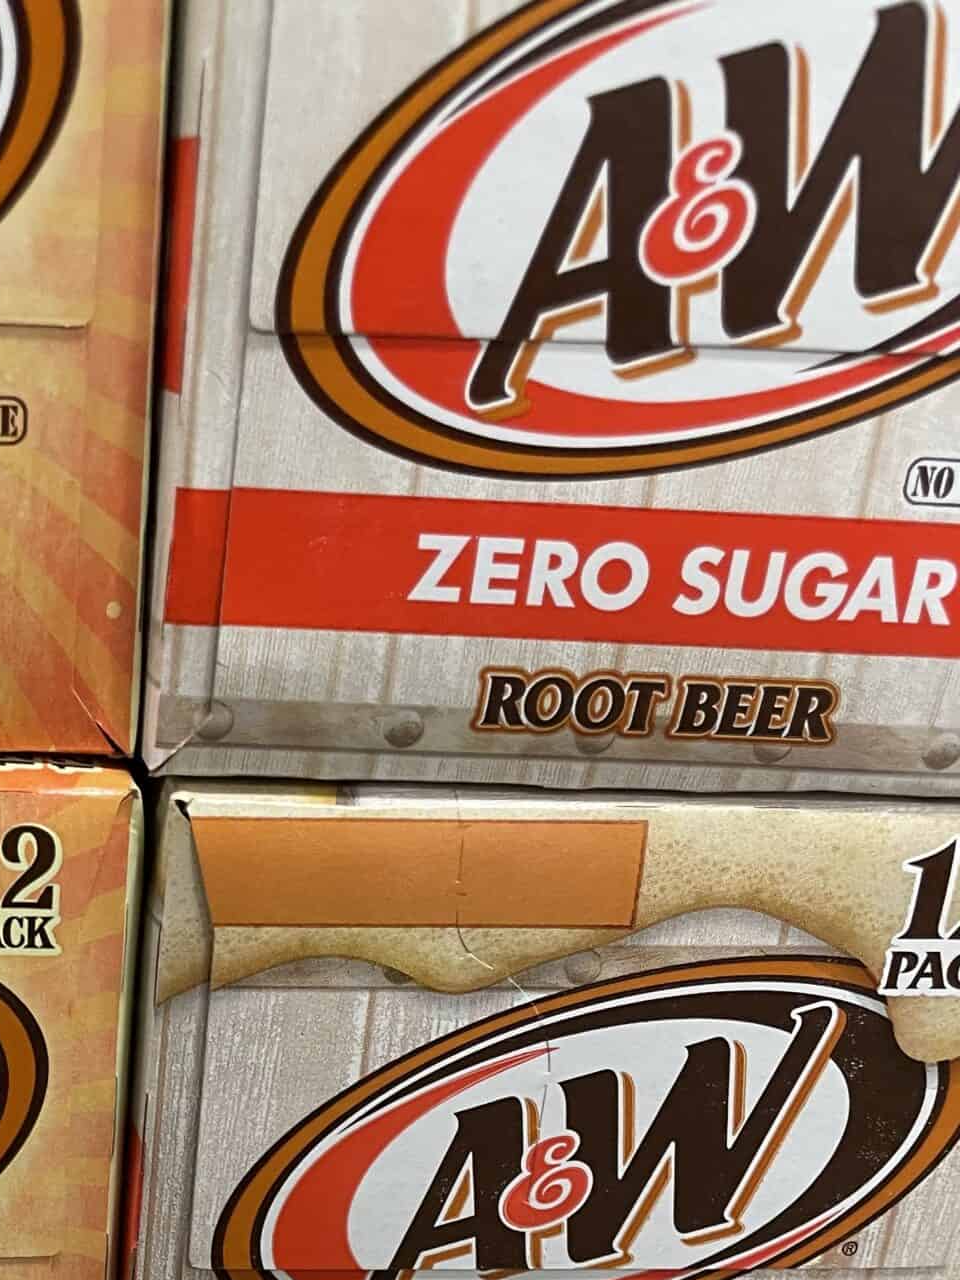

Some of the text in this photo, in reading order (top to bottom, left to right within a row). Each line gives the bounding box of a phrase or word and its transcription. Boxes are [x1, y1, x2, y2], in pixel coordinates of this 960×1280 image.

[465, 0, 960, 418] A&W
[911, 465, 955, 498] NO
[408, 532, 959, 626] ZERO SUGAR
[476, 671, 836, 741] ROOT BEER
[897, 839, 960, 940] 1
